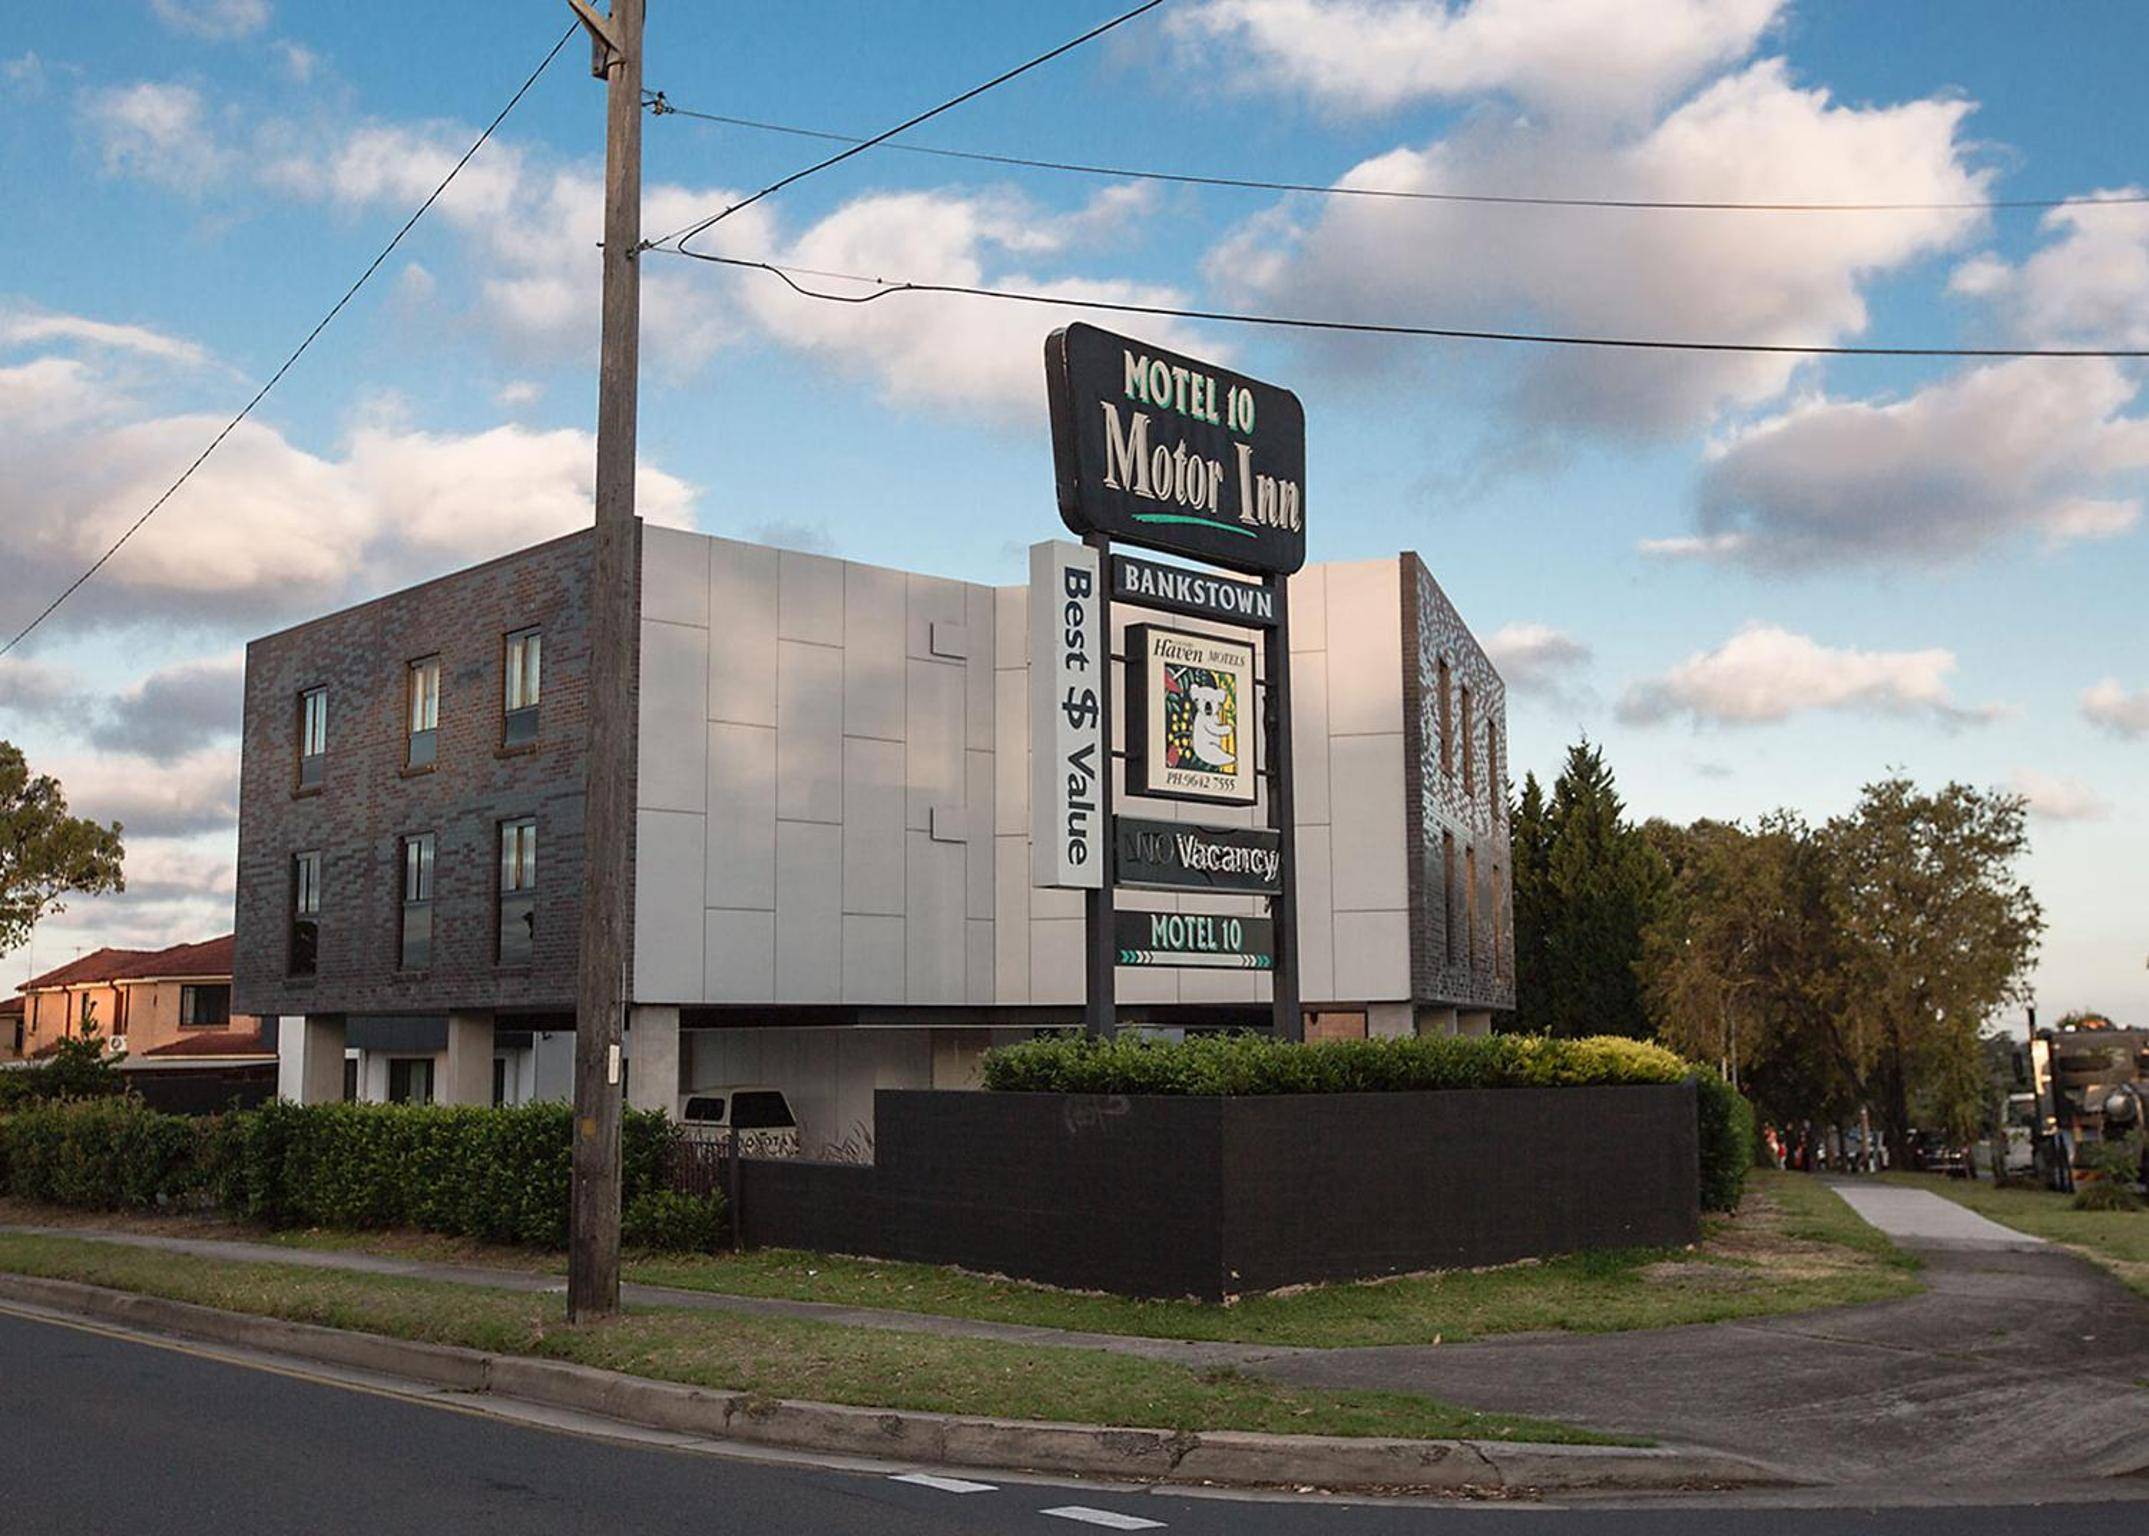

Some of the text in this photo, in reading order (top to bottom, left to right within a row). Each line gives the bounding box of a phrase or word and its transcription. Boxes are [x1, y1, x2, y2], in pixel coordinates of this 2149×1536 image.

[1124, 350, 1255, 434] MOTEL 10
[1100, 400, 1300, 532] Motor Inn
[1125, 564, 1272, 618] BANKSTOWN
[1153, 638, 1245, 666] Haven MOTELS
[1062, 566, 1099, 865] Best $ Value
[1175, 832, 1280, 882] Vacancy
[1151, 914, 1242, 951] MOTEL 10
